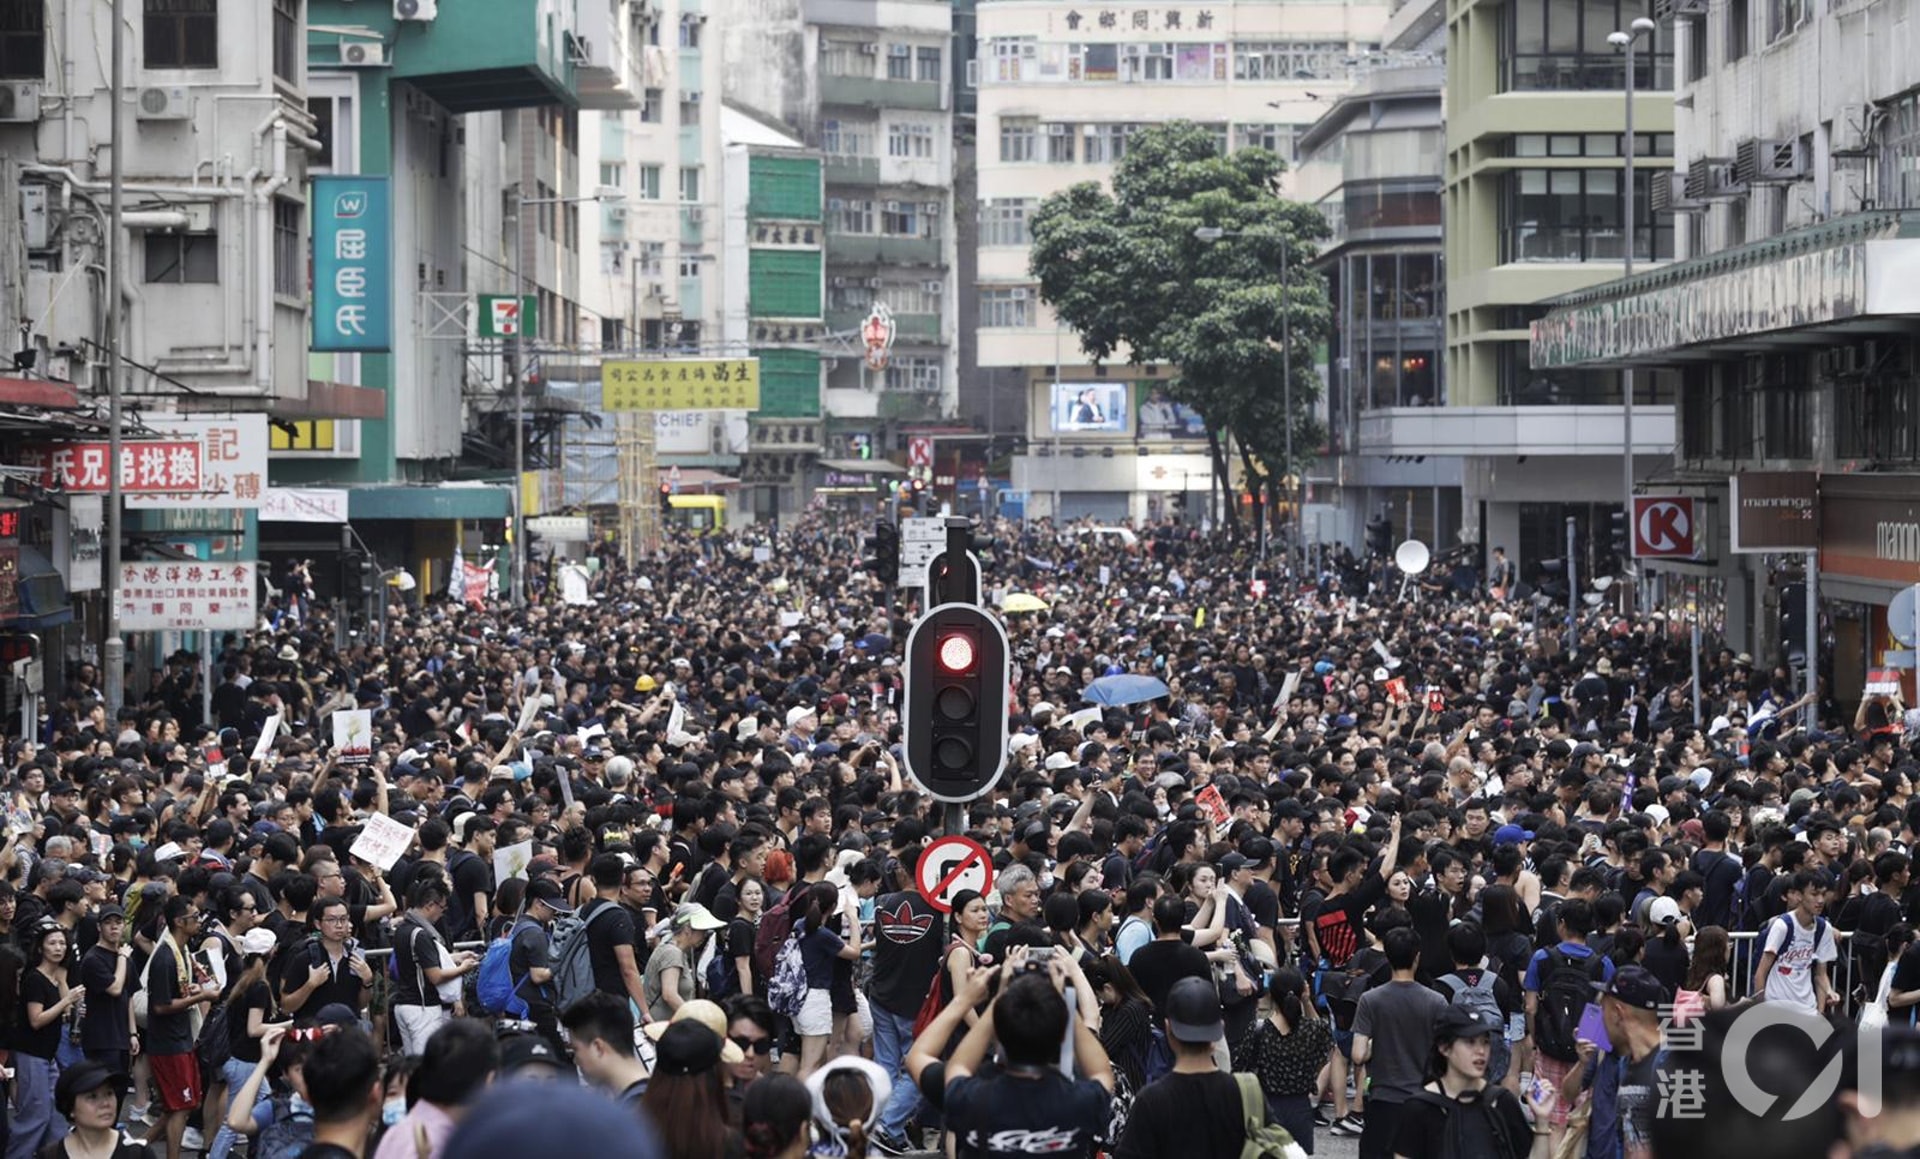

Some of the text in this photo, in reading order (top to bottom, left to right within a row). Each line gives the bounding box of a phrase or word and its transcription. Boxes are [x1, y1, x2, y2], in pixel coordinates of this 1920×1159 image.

[335, 228, 366, 335] 屈臣氏
[1743, 496, 1812, 509] mannings
